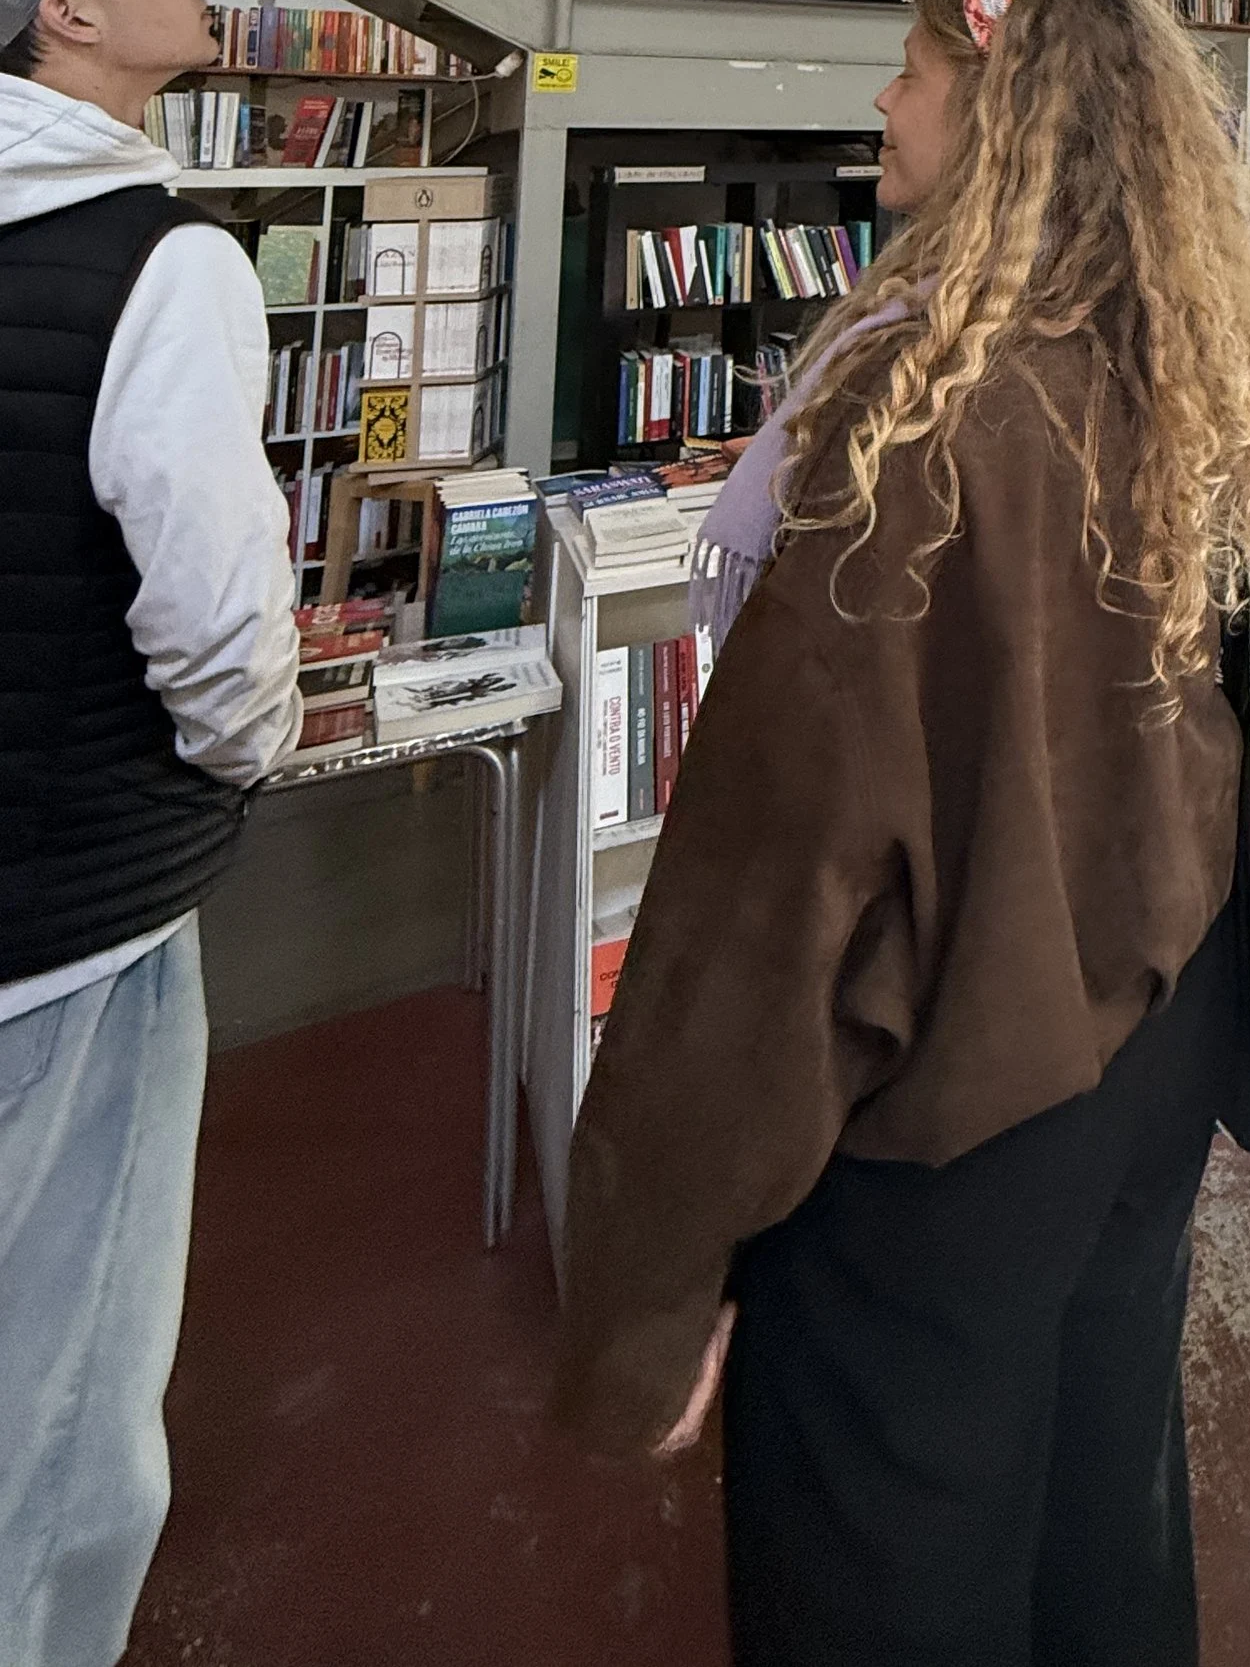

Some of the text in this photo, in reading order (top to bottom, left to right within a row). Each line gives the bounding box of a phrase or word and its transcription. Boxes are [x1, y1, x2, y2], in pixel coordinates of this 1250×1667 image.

[452, 508, 492, 523] GABRIELA
[608, 695, 622, 734] CONTRA
[608, 744, 621, 776] VENTO
